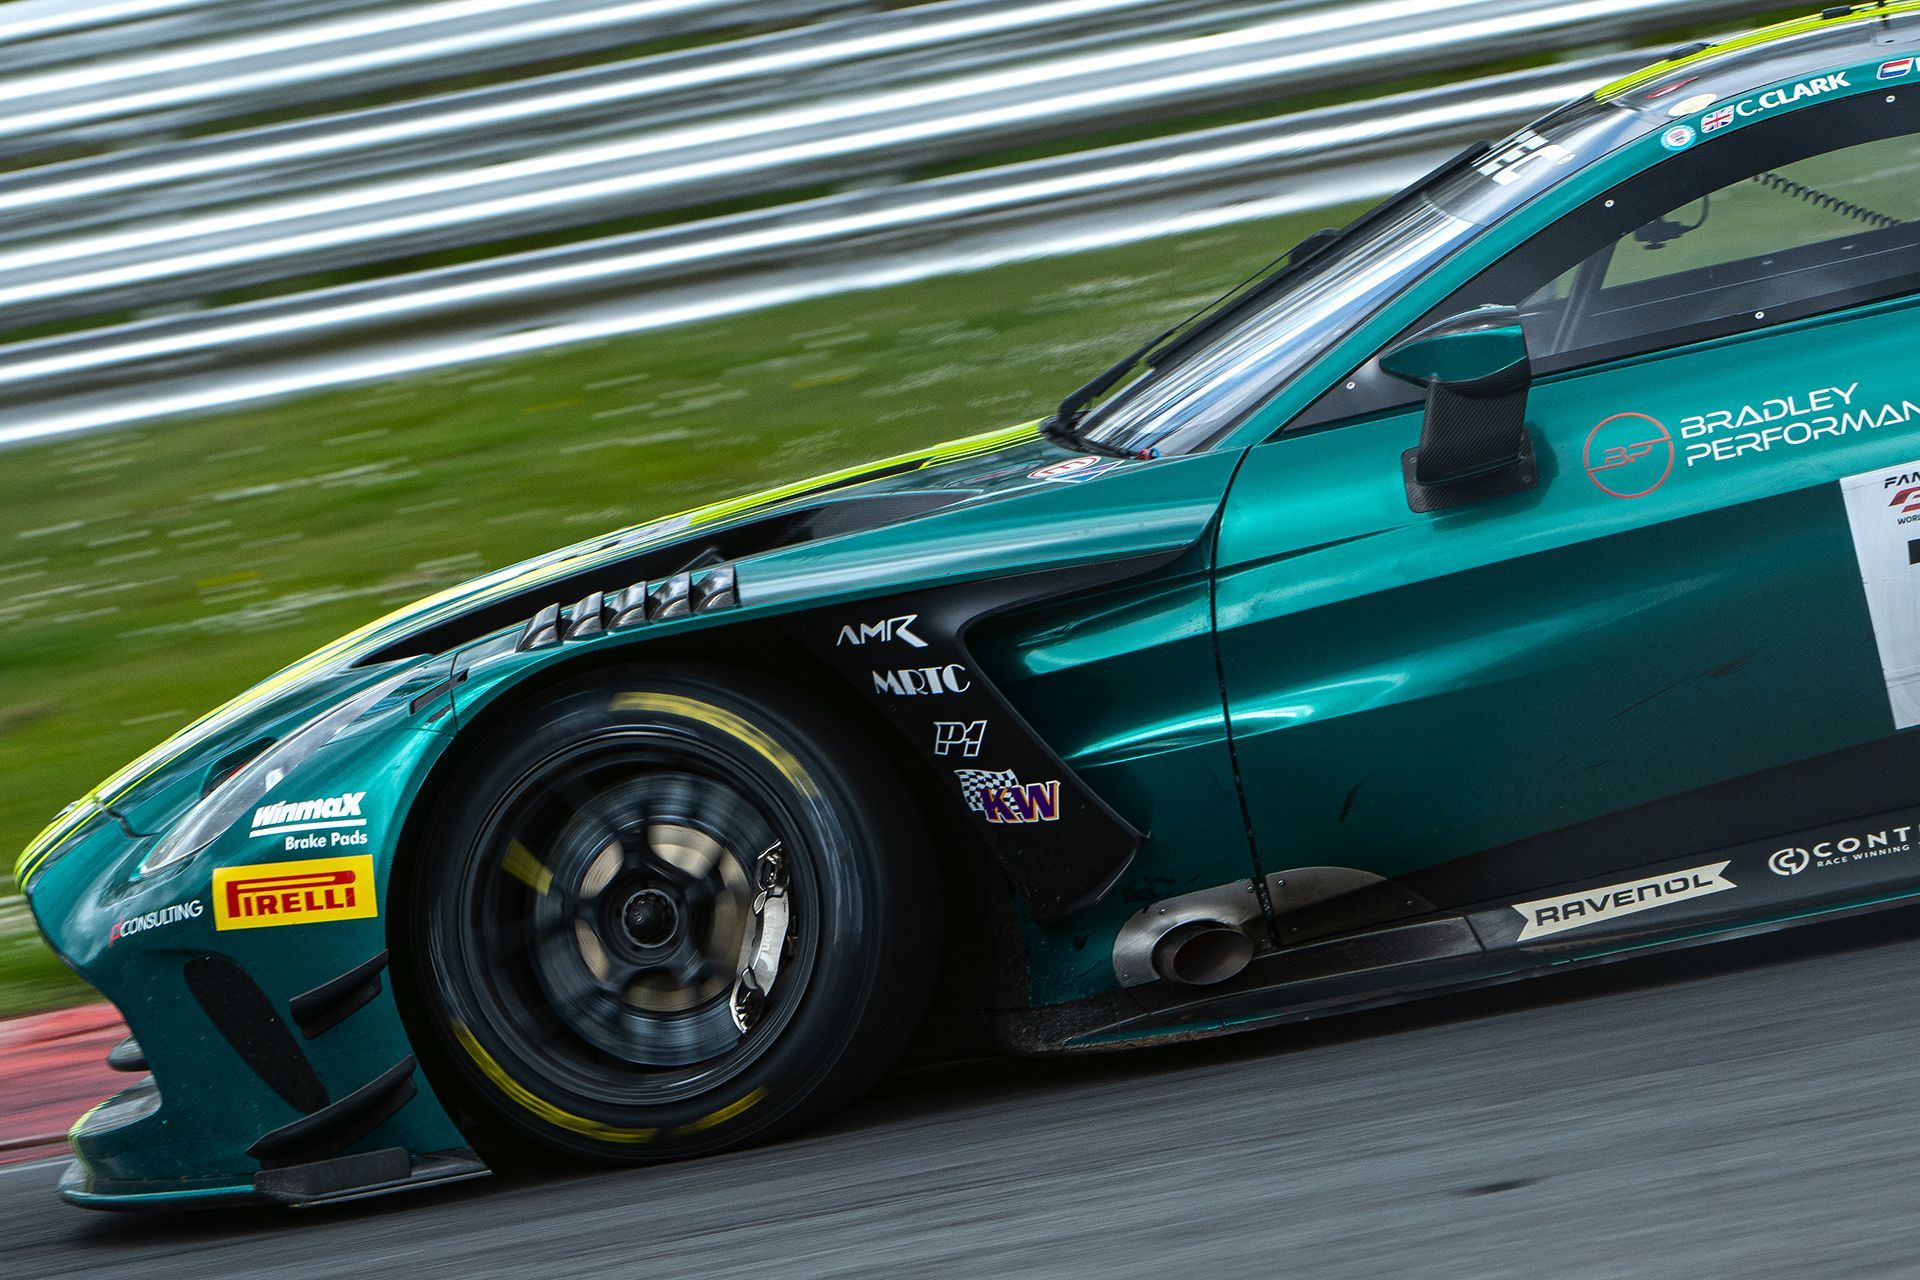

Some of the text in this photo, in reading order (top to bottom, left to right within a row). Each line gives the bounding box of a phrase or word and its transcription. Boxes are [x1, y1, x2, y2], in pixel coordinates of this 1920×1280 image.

[1735, 71, 1852, 118] C.CLARK
[1680, 382, 1859, 439] BRADLEY
[836, 614, 929, 648] AMR
[872, 664, 971, 696] MRTC
[933, 719, 988, 757] P1
[979, 780, 1061, 824] KW
[285, 829, 368, 851] Brake Pads
[1812, 825, 1920, 858] CONT
[1816, 844, 1911, 868] RACE WINNING
[226, 870, 357, 919] PIRELLI
[1535, 874, 1714, 927] RAVENOL
